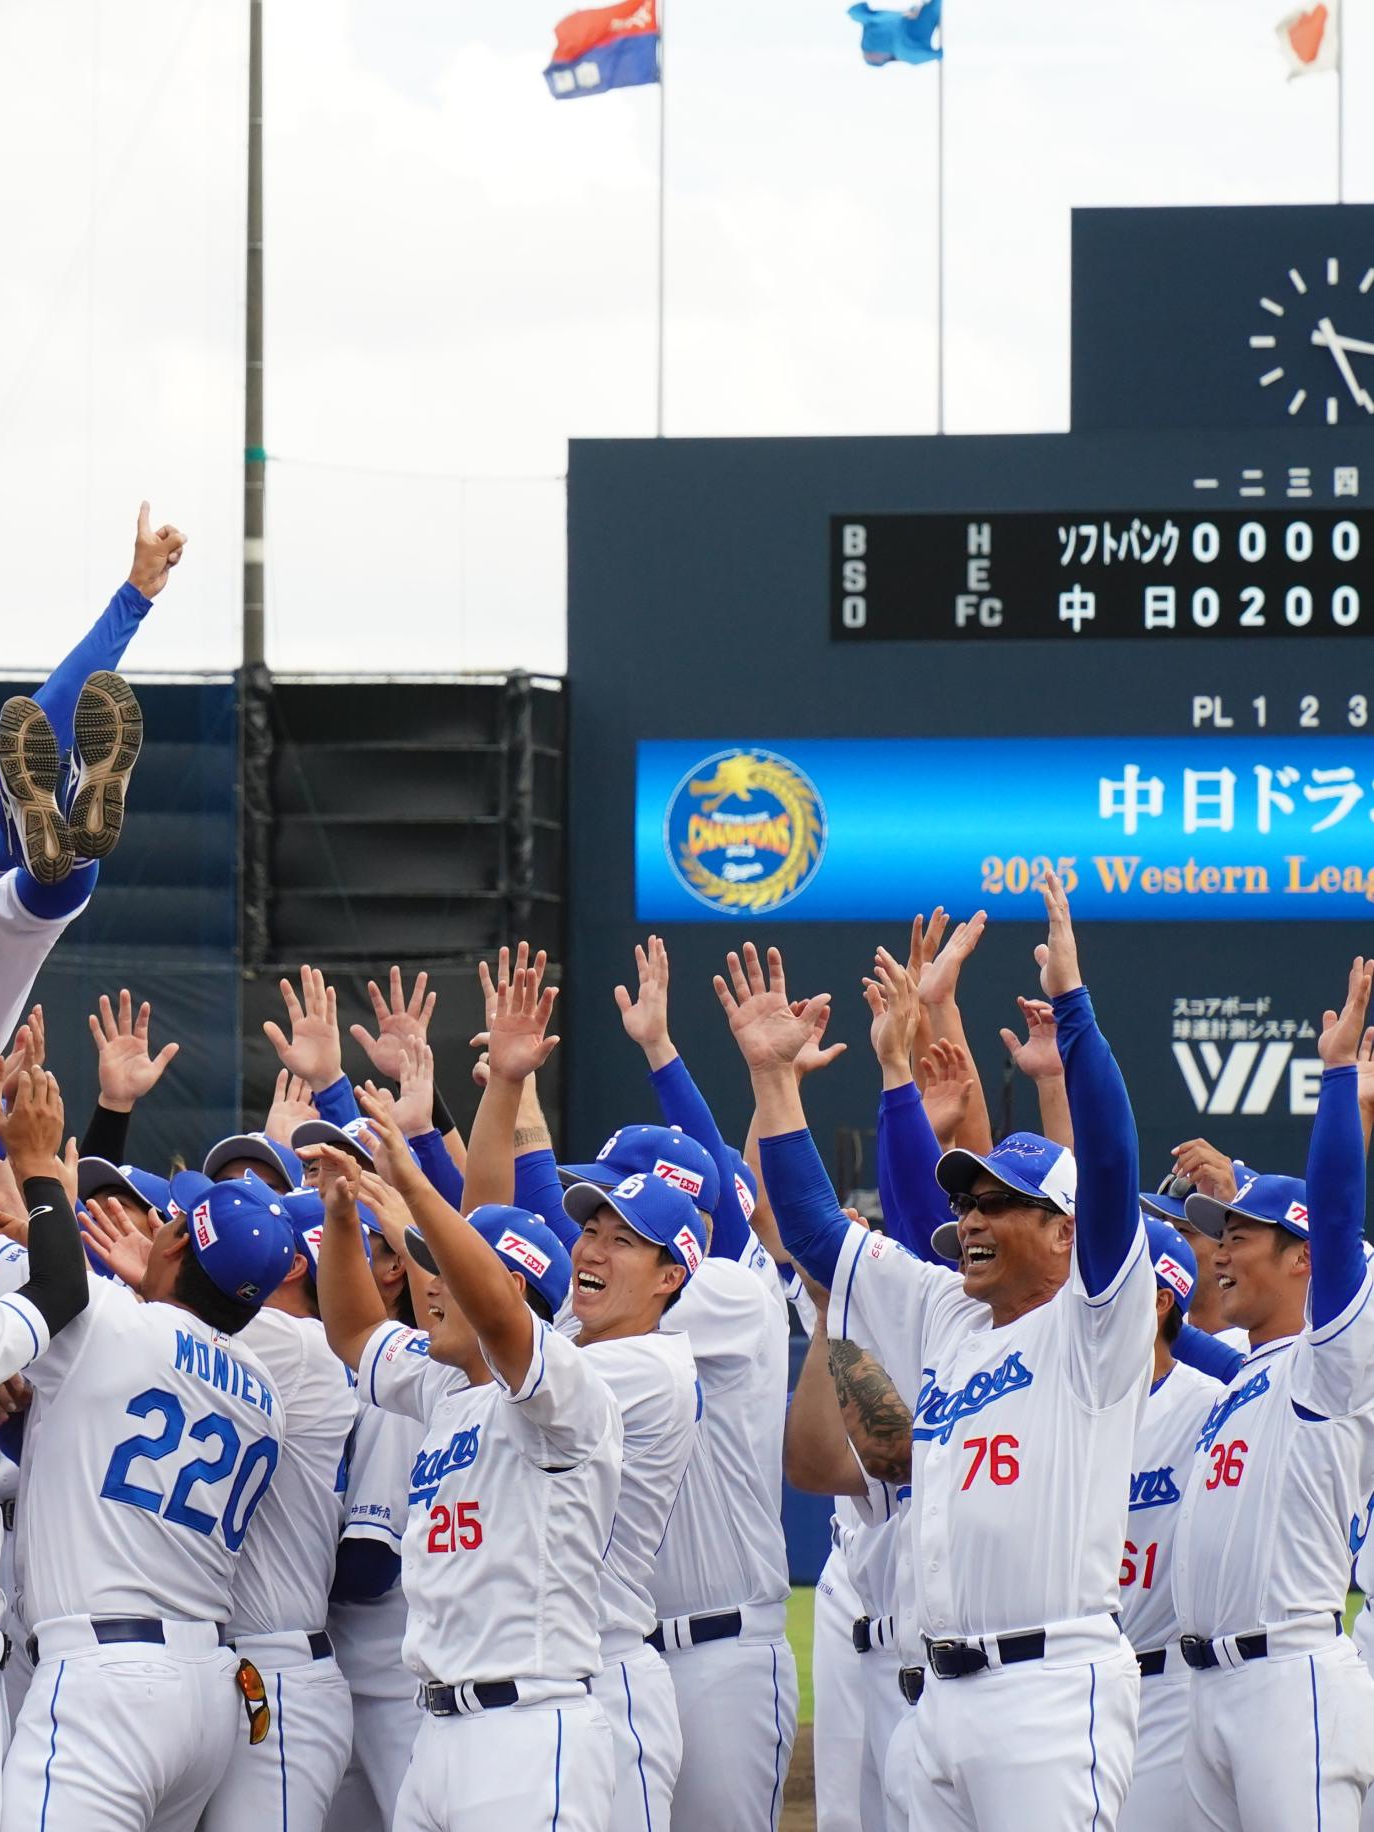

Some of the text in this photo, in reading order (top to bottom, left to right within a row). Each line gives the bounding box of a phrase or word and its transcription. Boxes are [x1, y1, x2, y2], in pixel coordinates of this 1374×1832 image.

[1239, 469, 1266, 497] 二
[1286, 467, 1313, 497] 三
[1333, 466, 1359, 497] 四
[842, 524, 867, 557] B
[967, 522, 992, 556] H
[1058, 518, 1179, 566] ソフトバンク
[842, 559, 867, 593] S
[967, 558, 992, 592] E
[1193, 694, 1369, 728] PL 1 2 3
[1098, 763, 1374, 836] 中日ドラ
[981, 855, 1079, 895] 2025
[1092, 855, 1270, 894] Western
[99, 1386, 279, 1553] 220
[961, 1434, 1020, 1491] 76
[1206, 1439, 1249, 1491] 36
